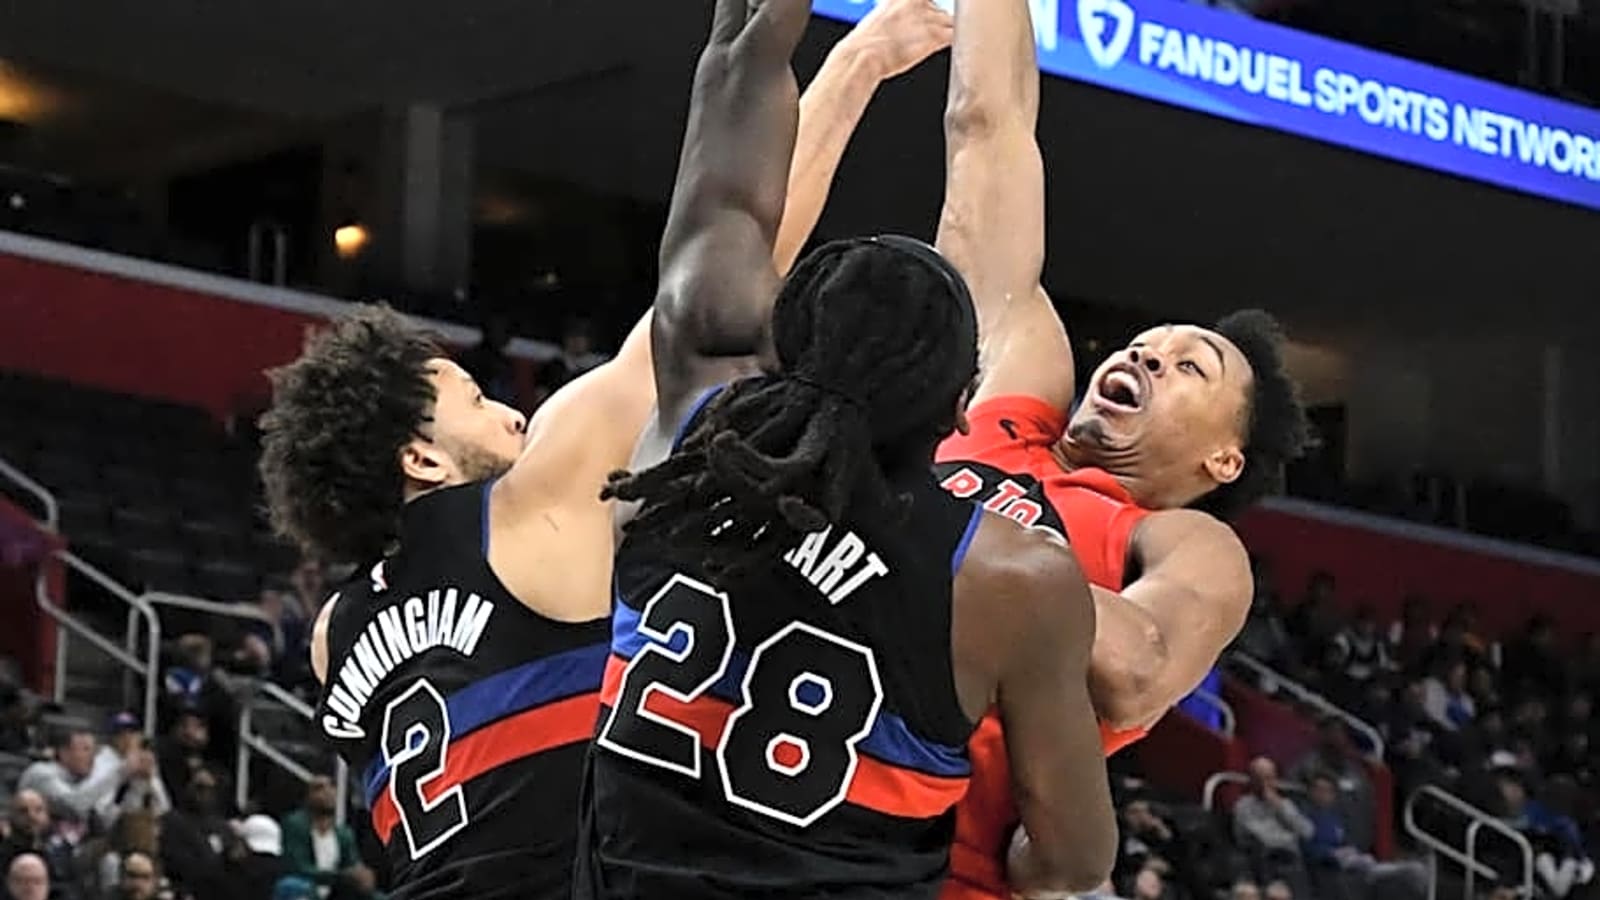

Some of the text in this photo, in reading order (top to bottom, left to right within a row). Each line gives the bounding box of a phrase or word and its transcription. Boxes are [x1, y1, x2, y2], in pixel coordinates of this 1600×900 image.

[1139, 22, 1311, 108] FANDUEL
[1314, 68, 1449, 141] SPORTS
[1453, 103, 1600, 181] NETWOR
[783, 523, 889, 605] ART
[381, 678, 468, 860] 2
[598, 573, 883, 827] 28
